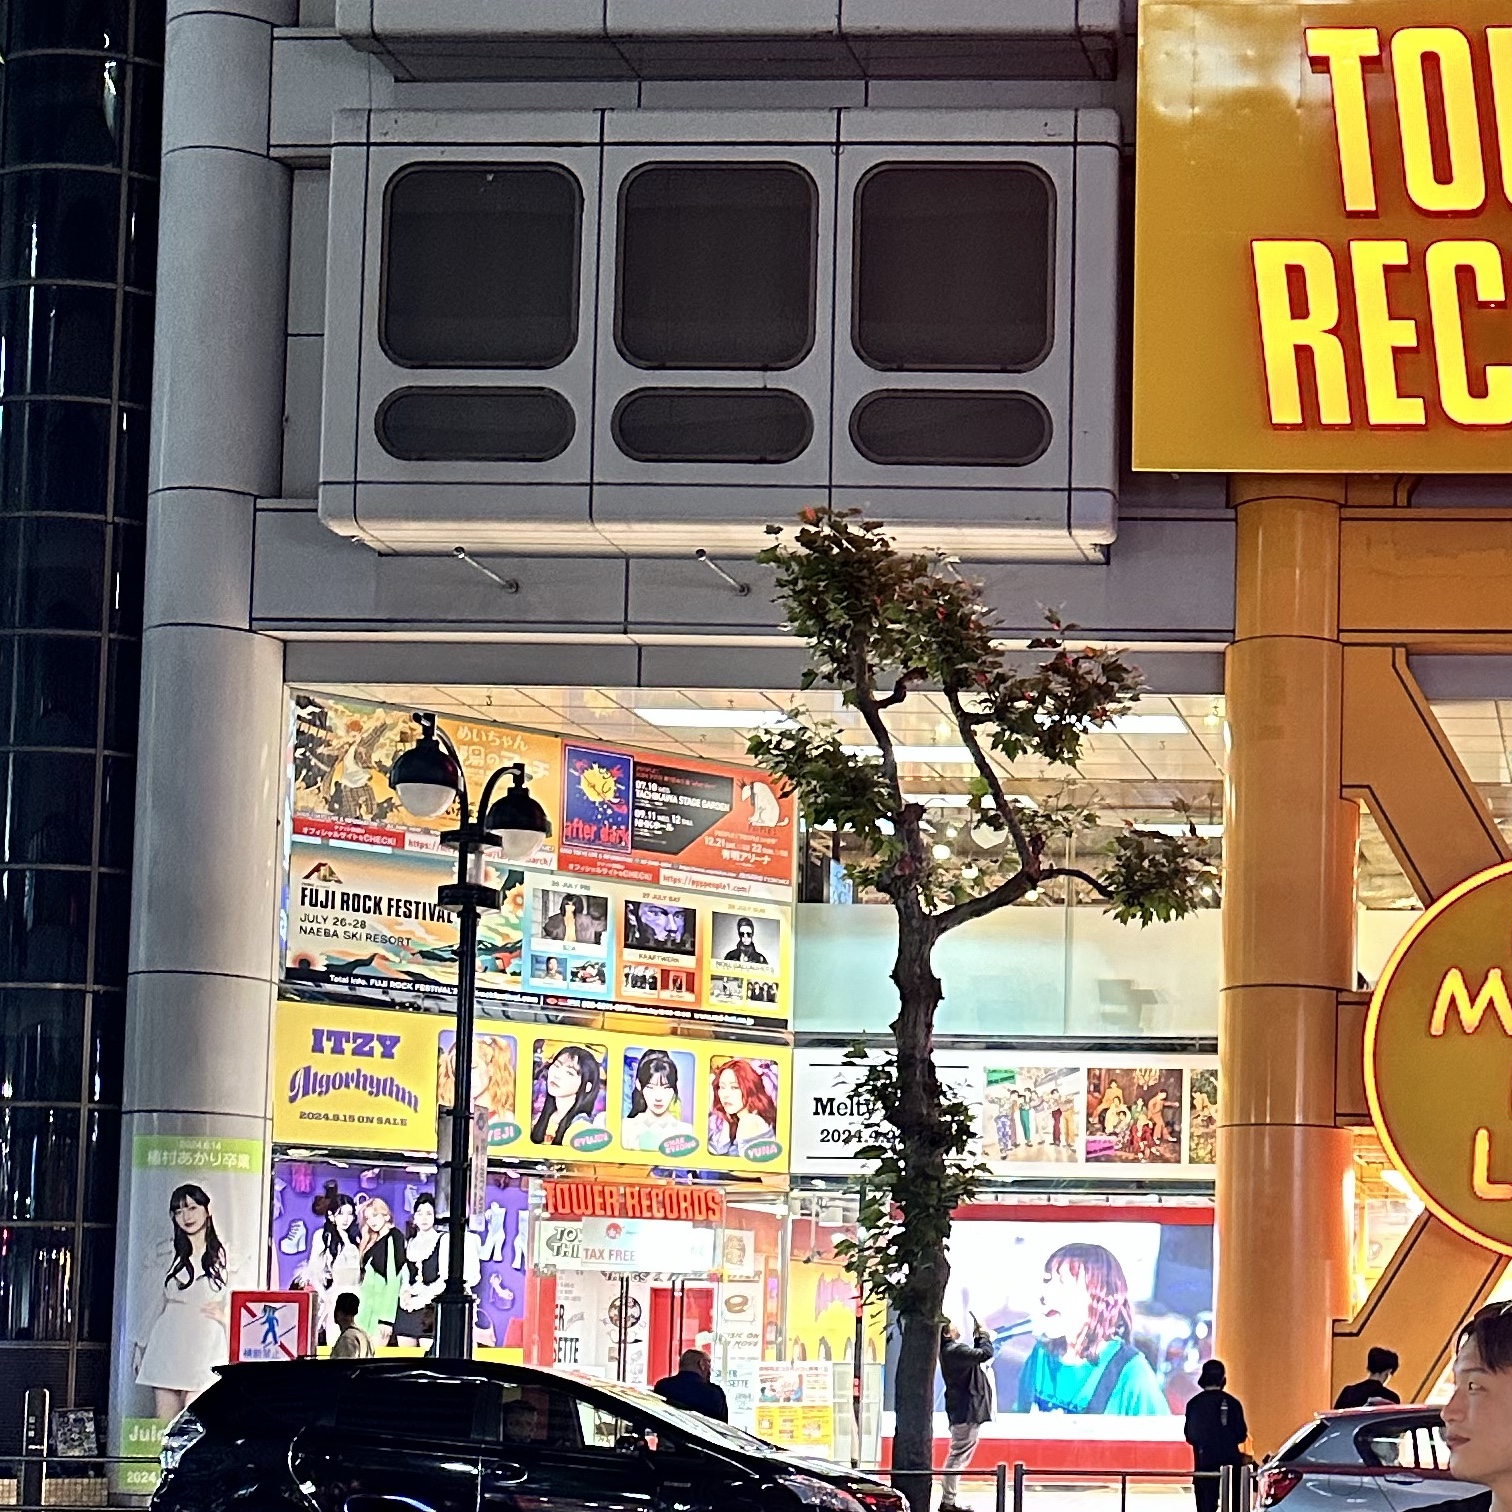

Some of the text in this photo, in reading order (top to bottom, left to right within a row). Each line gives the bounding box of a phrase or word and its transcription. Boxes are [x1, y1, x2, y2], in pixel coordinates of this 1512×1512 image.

[457, 725, 528, 752] めいちゃん
[459, 745, 550, 779] 陽のマチ
[564, 817, 596, 842] after
[301, 887, 454, 924] FUJI ROCK FESTIVAL
[300, 913, 367, 930] JULY 26-28
[299, 926, 412, 947] NAEBA SKI RESORT
[329, 973, 349, 984] Total
[369, 978, 388, 988] FUJI
[389, 980, 414, 991] ROCK
[311, 1028, 401, 1060] ITZY
[288, 1064, 419, 1114] Algorhythm
[357, 1116, 375, 1125] ON
[376, 1117, 408, 1127] SALE
[748, 1144, 778, 1160] YUNA
[542, 1180, 721, 1221] TOWER RECORDS
[583, 1246, 637, 1262] TAX FREE
